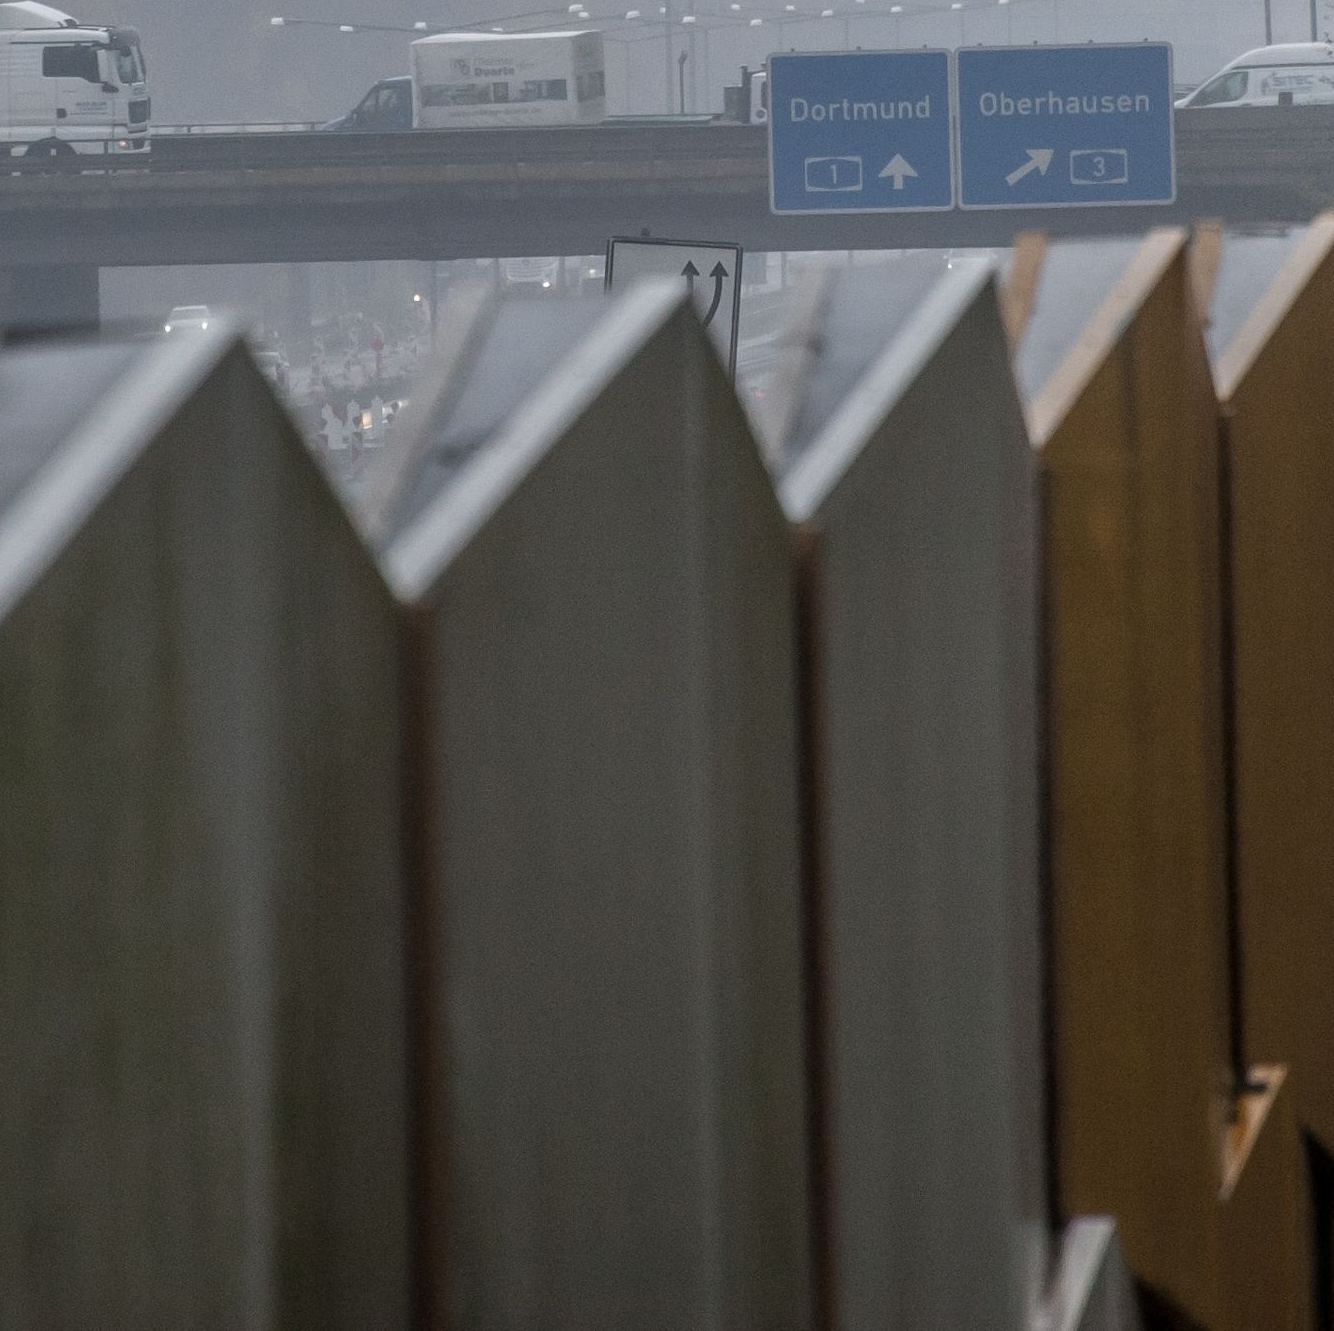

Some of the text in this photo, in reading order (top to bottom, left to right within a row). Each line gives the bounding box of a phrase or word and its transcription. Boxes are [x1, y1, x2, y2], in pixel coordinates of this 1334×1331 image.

[790, 94, 931, 122] Dortmund
[979, 91, 1150, 117] Oberhausen
[830, 164, 838, 185] 1
[1092, 156, 1107, 177] 3
